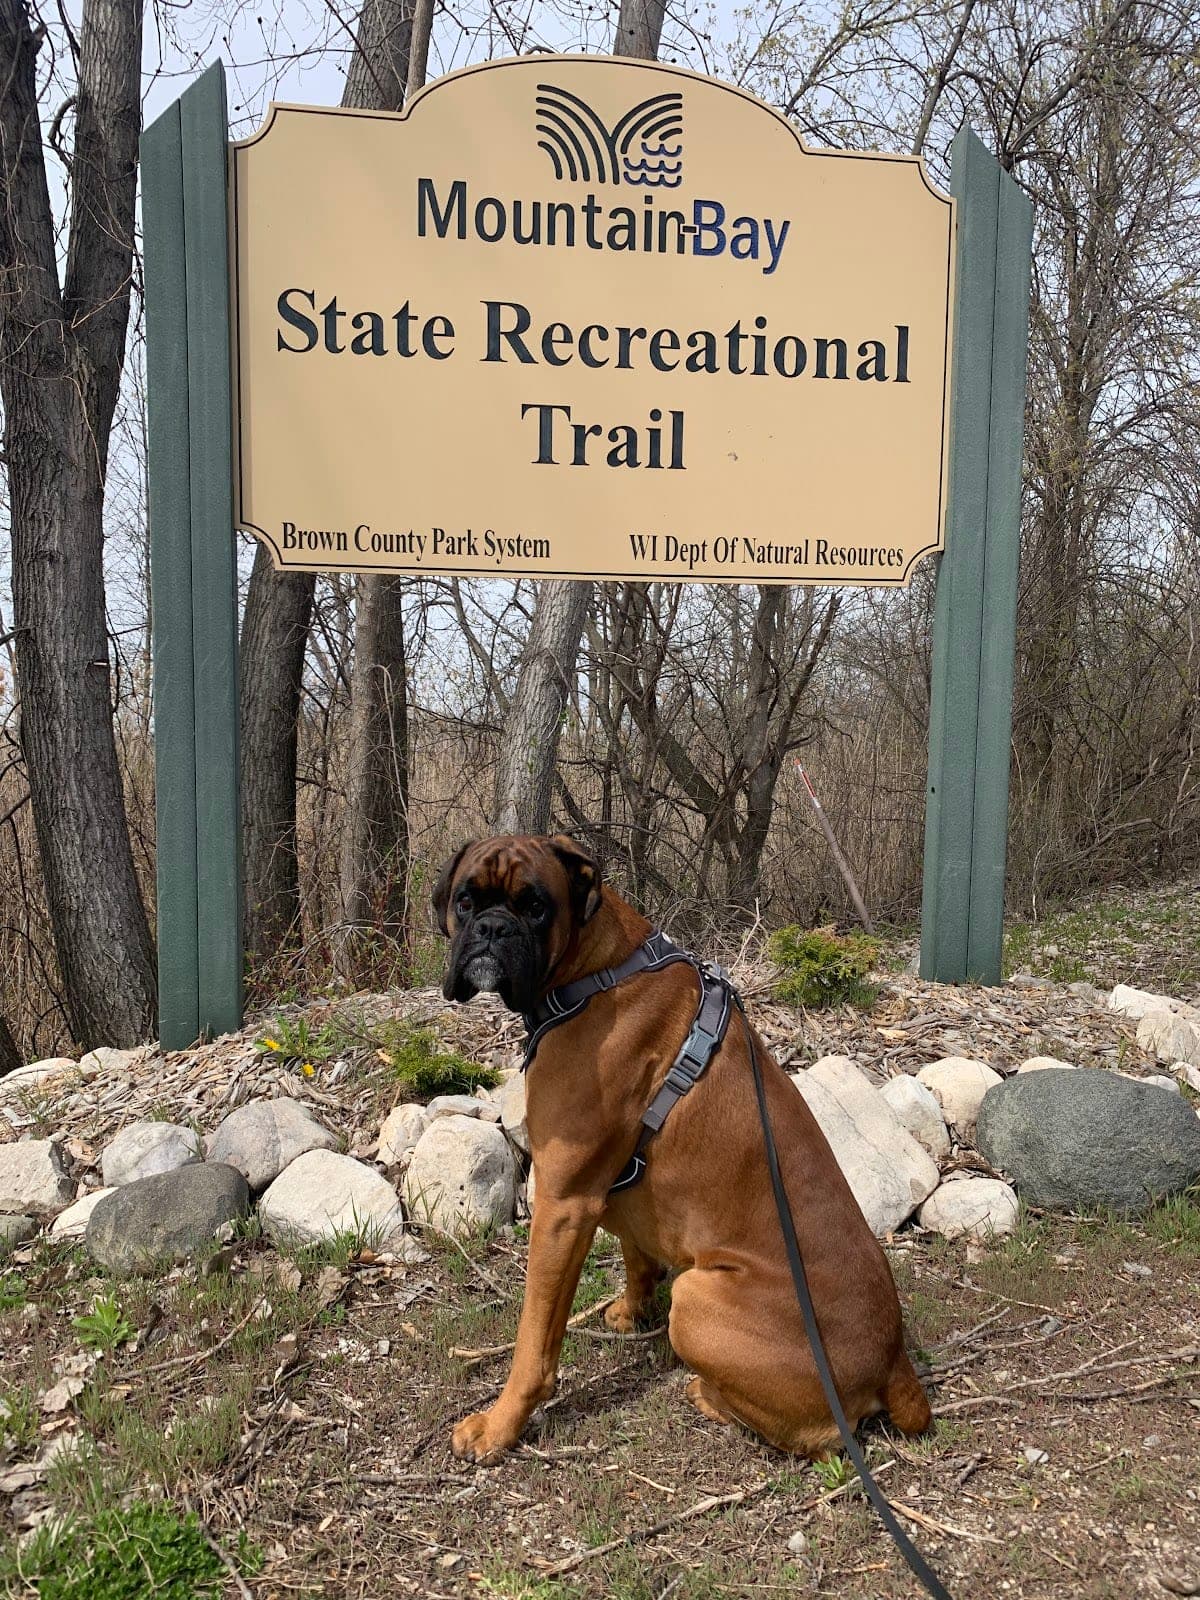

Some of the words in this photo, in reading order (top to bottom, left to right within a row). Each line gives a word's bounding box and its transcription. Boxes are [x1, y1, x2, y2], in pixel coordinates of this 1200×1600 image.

[417, 177, 791, 276] Mountain-Bay
[277, 288, 455, 361] State
[480, 300, 912, 384] Recreational
[521, 403, 687, 470] Trail
[282, 521, 348, 552] Brown
[354, 524, 426, 562] County
[431, 527, 480, 556] Park
[484, 529, 551, 564] System
[629, 534, 658, 562] WI
[663, 535, 709, 571] Dept
[713, 536, 739, 564] Of
[742, 537, 809, 565] Natural
[815, 539, 904, 567] Resources
